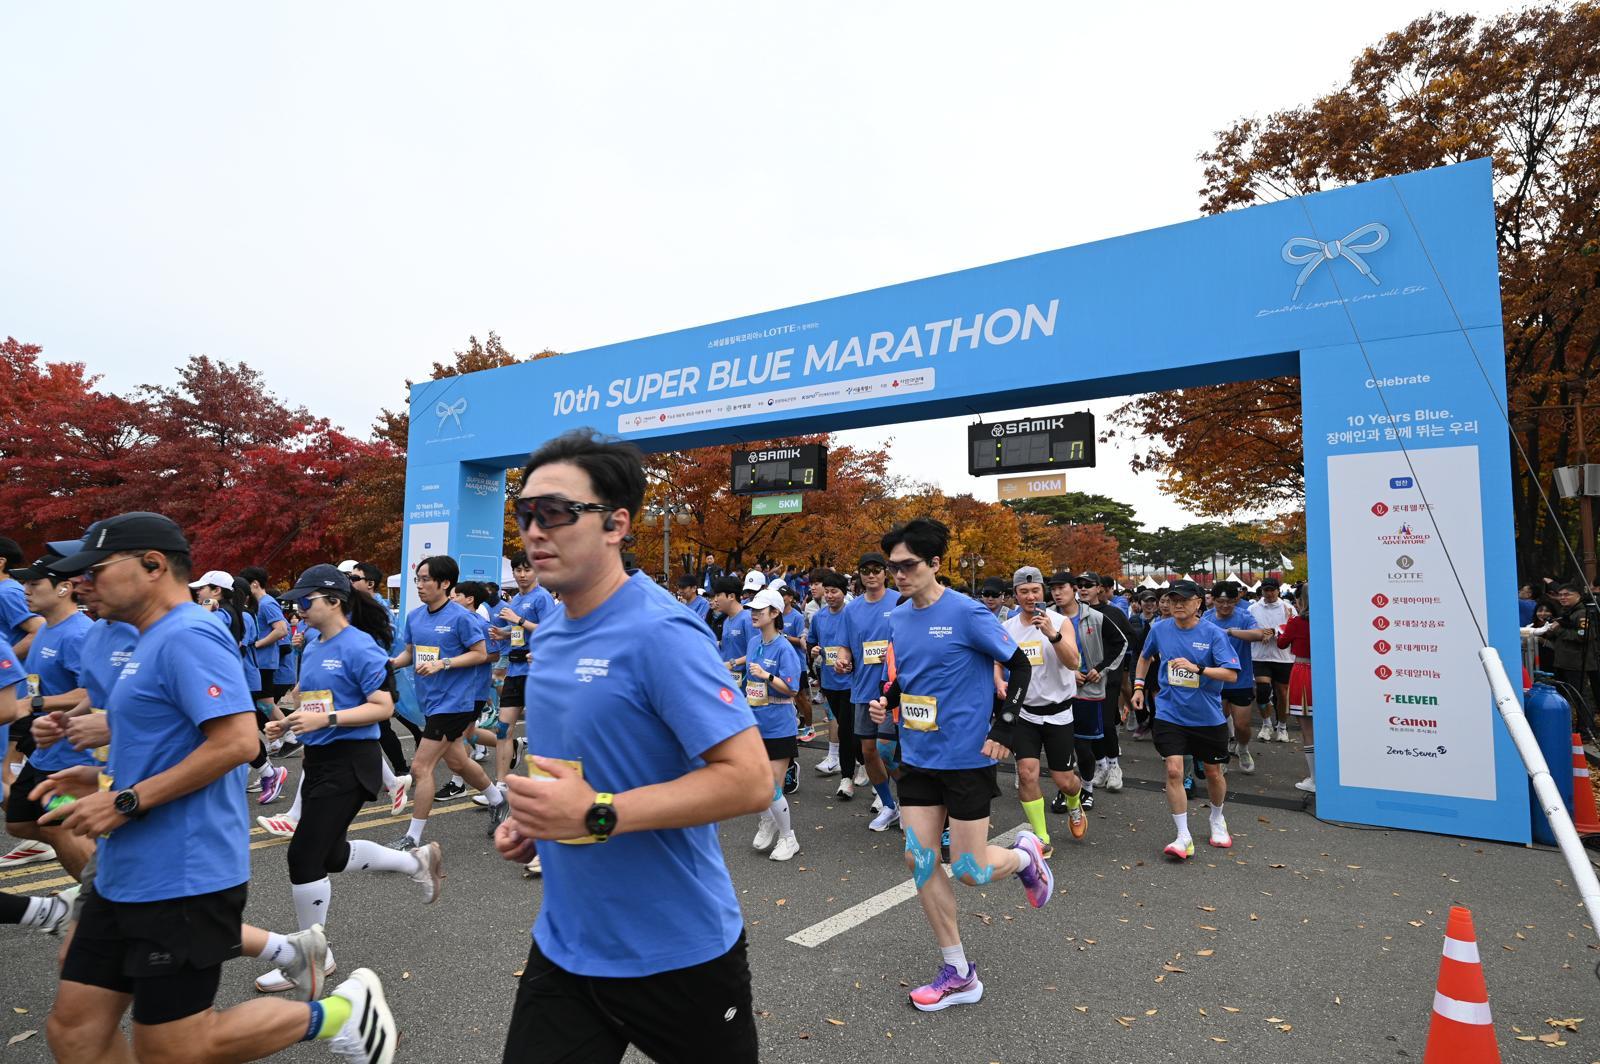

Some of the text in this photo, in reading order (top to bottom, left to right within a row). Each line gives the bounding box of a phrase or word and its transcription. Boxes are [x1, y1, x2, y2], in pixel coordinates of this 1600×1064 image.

[553, 298, 1060, 416] 10th SUPER BLUE MARATHON
[1365, 373, 1431, 389] Celebrate
[1346, 409, 1454, 427] 10 Years Blue.
[1006, 418, 1064, 435] SAMIK
[1326, 420, 1479, 445] 장애인과 함께 뛰는 우리
[758, 449, 800, 461] SAMIK
[1027, 480, 1062, 492] 10KM
[779, 499, 799, 509] 5KM
[1388, 572, 1424, 580] LOTTE
[1392, 596, 1441, 605] 롯데하이마트
[1394, 619, 1445, 628] 롯데칠성음료
[1395, 643, 1438, 653] 롯데케미칼
[1171, 668, 1194, 680] 11622
[1395, 668, 1441, 679] 롯데알미늄
[1384, 693, 1438, 706] 7-ELEVEN
[905, 705, 929, 719] 11071
[1388, 716, 1437, 728] Canon
[1386, 745, 1404, 755] Zero
[1412, 748, 1437, 758] Seven
